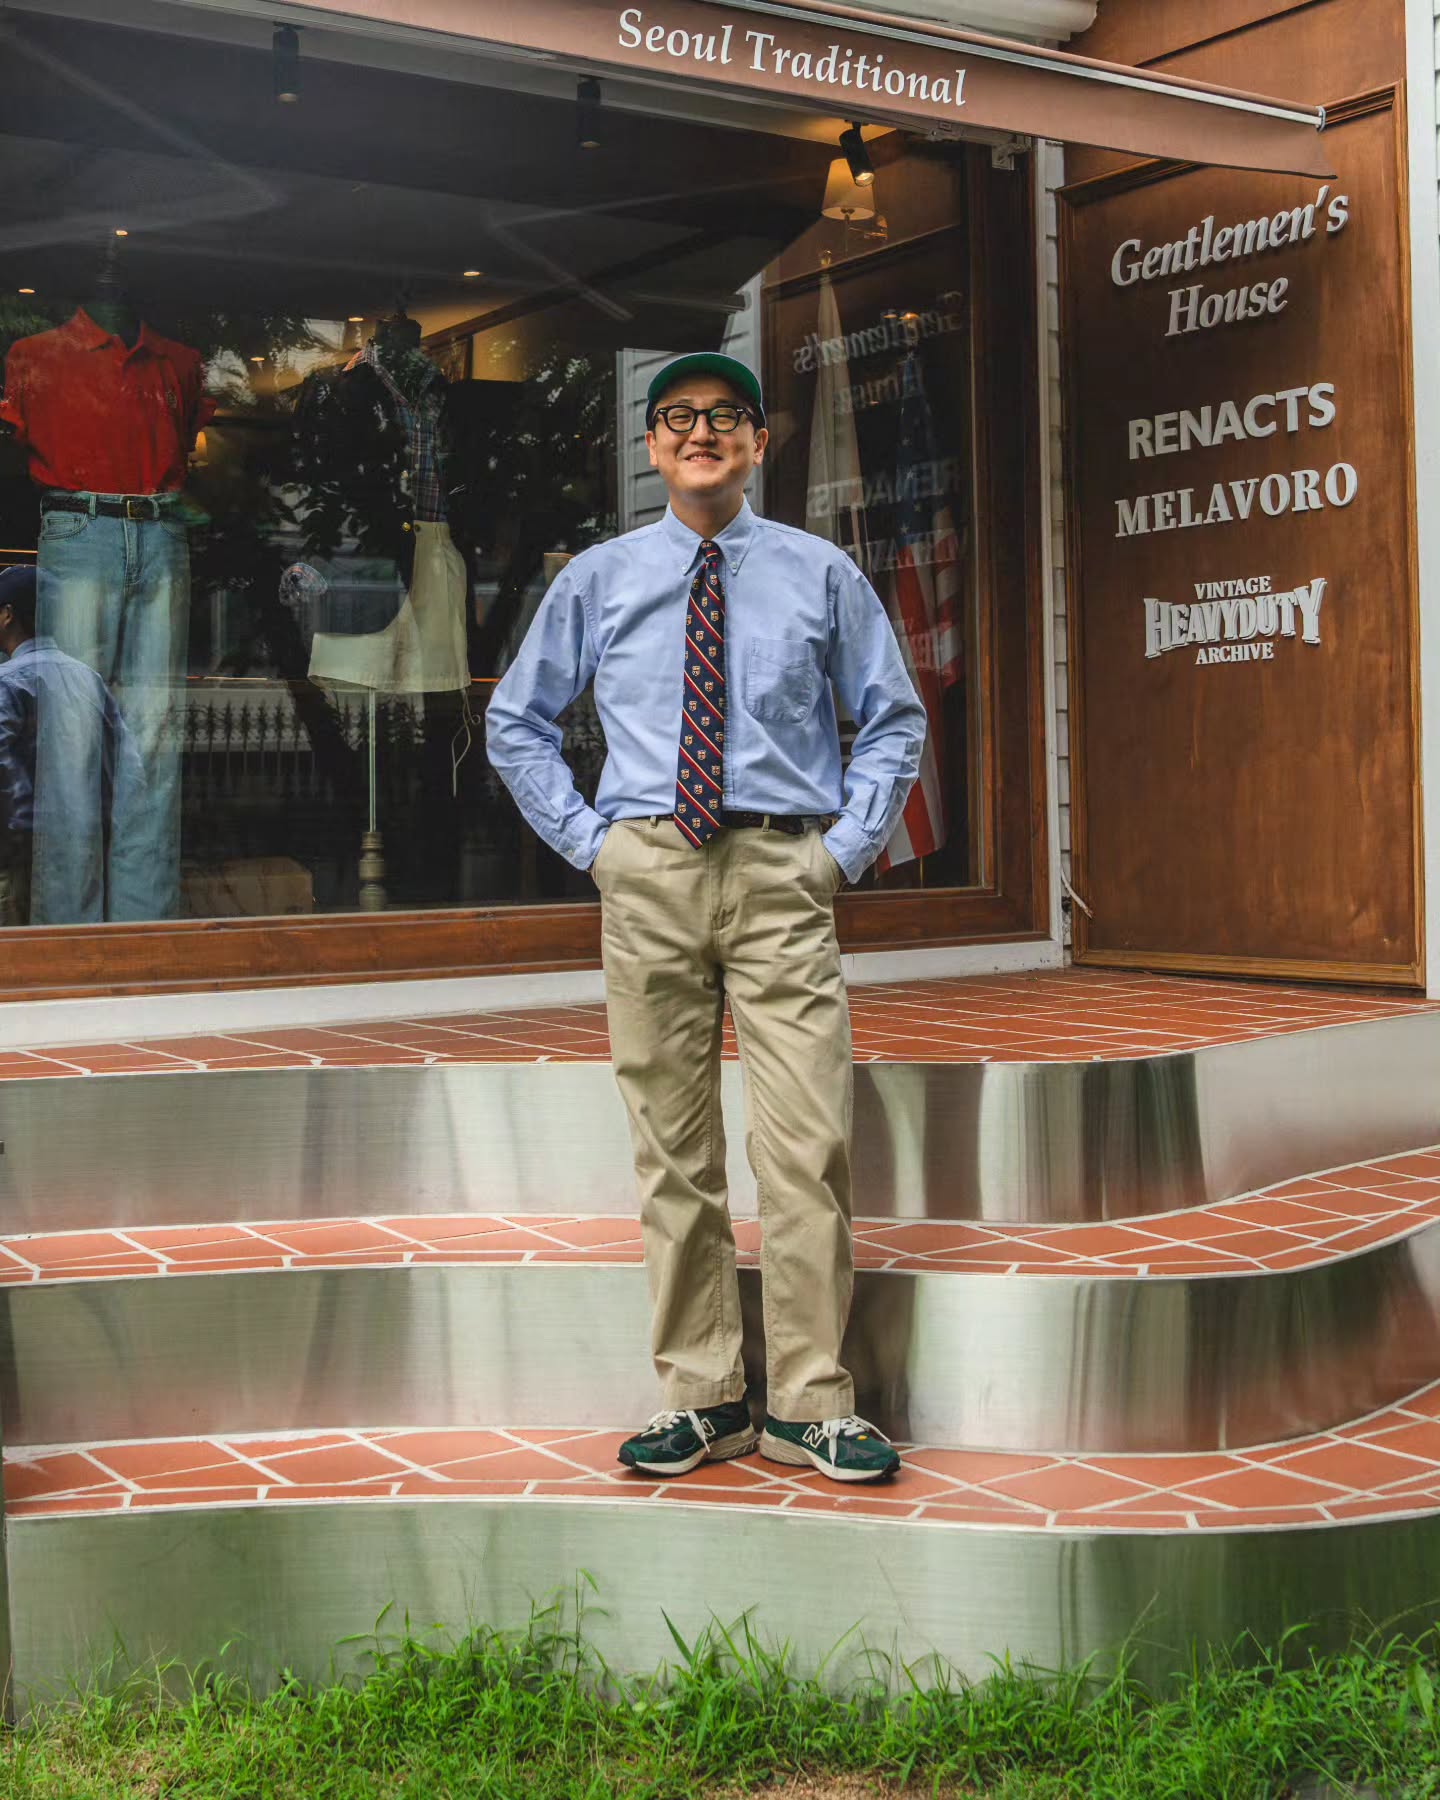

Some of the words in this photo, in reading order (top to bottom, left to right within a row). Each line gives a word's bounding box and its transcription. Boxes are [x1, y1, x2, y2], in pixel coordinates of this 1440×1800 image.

[618, 8, 733, 65] Seoul
[745, 30, 966, 106] Traditional
[1111, 185, 1349, 287] Gentlemen's
[1164, 277, 1289, 337] House
[1128, 382, 1336, 460] RENACTS
[1114, 462, 1358, 538] MELAVORO
[1143, 577, 1327, 659] HEAVYDUTY
[1194, 575, 1272, 600] VINTAGE
[1195, 642, 1275, 665] ARCHIVE
[802, 1423, 826, 1449] N
